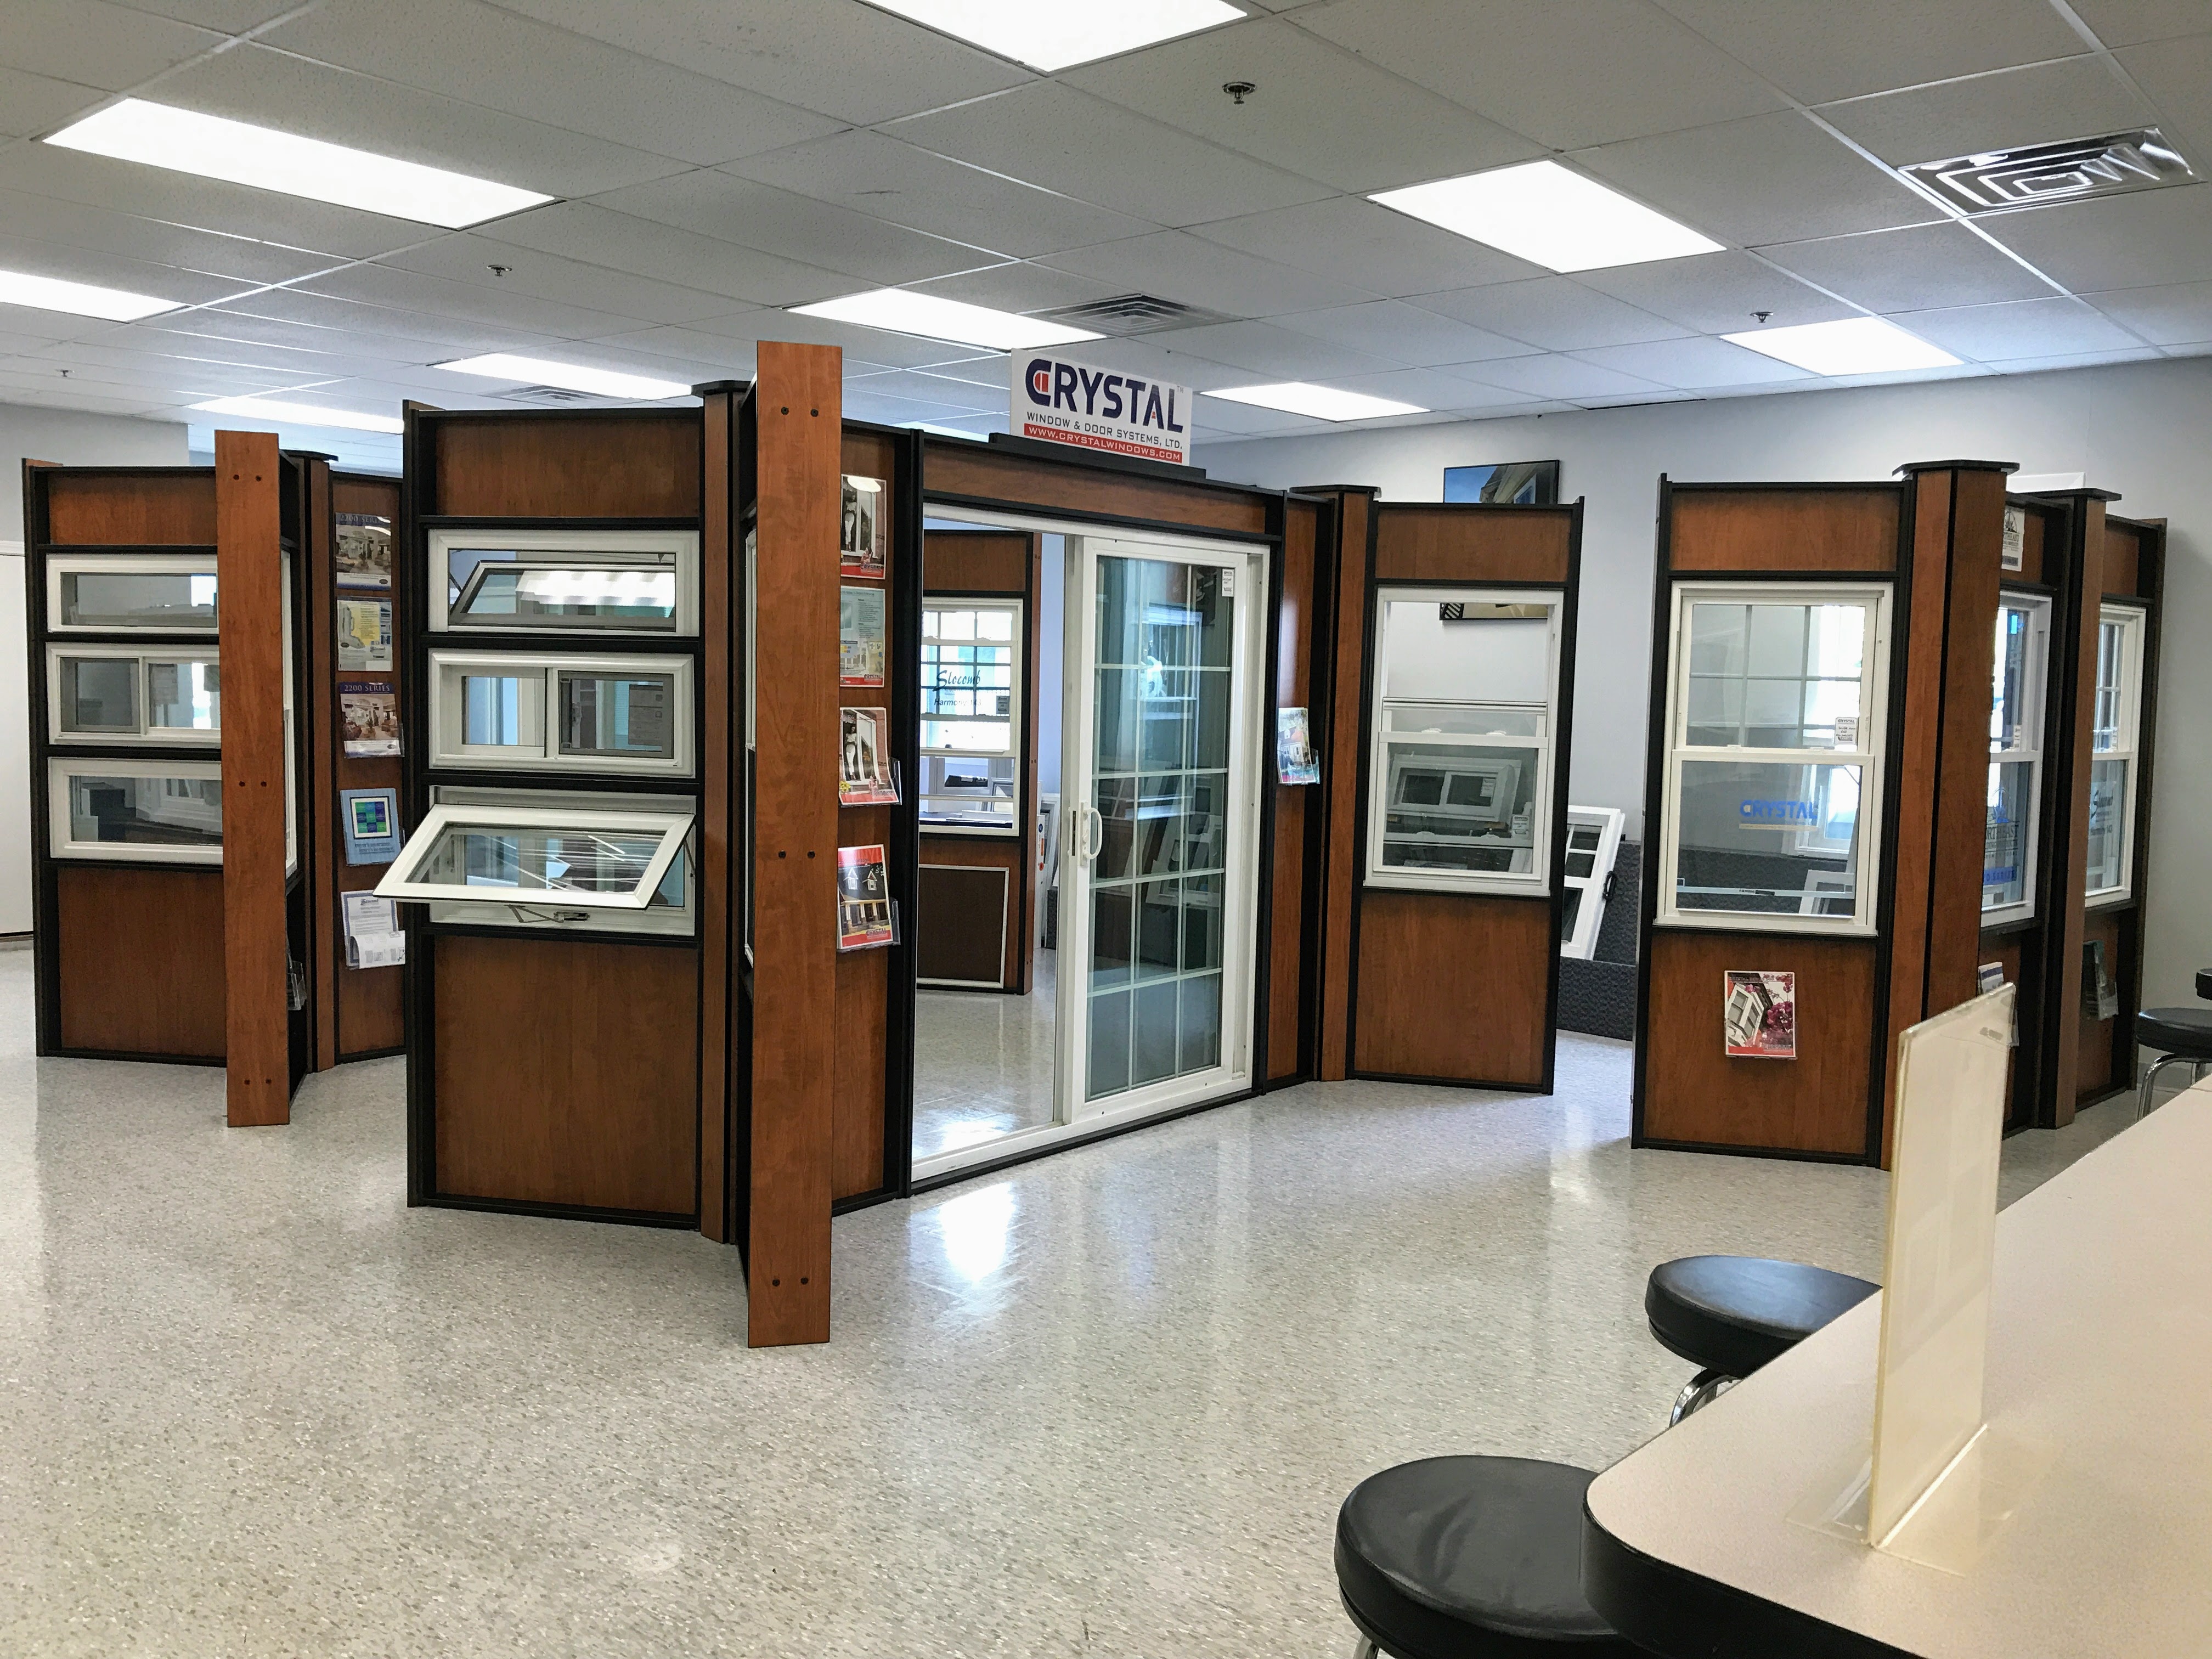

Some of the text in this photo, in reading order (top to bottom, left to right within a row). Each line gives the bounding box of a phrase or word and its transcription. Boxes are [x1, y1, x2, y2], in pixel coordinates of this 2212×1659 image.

[1025, 359, 1183, 433] CRYSTAL
[1027, 411, 1183, 449] WINDOW & DOOR SYSTEMS, LTD.
[1029, 426, 1180, 460] WWW.CRYSTALWINDOWS.COM
[932, 670, 981, 691] Slocomb
[1740, 799, 1818, 819] CRYSTAL
